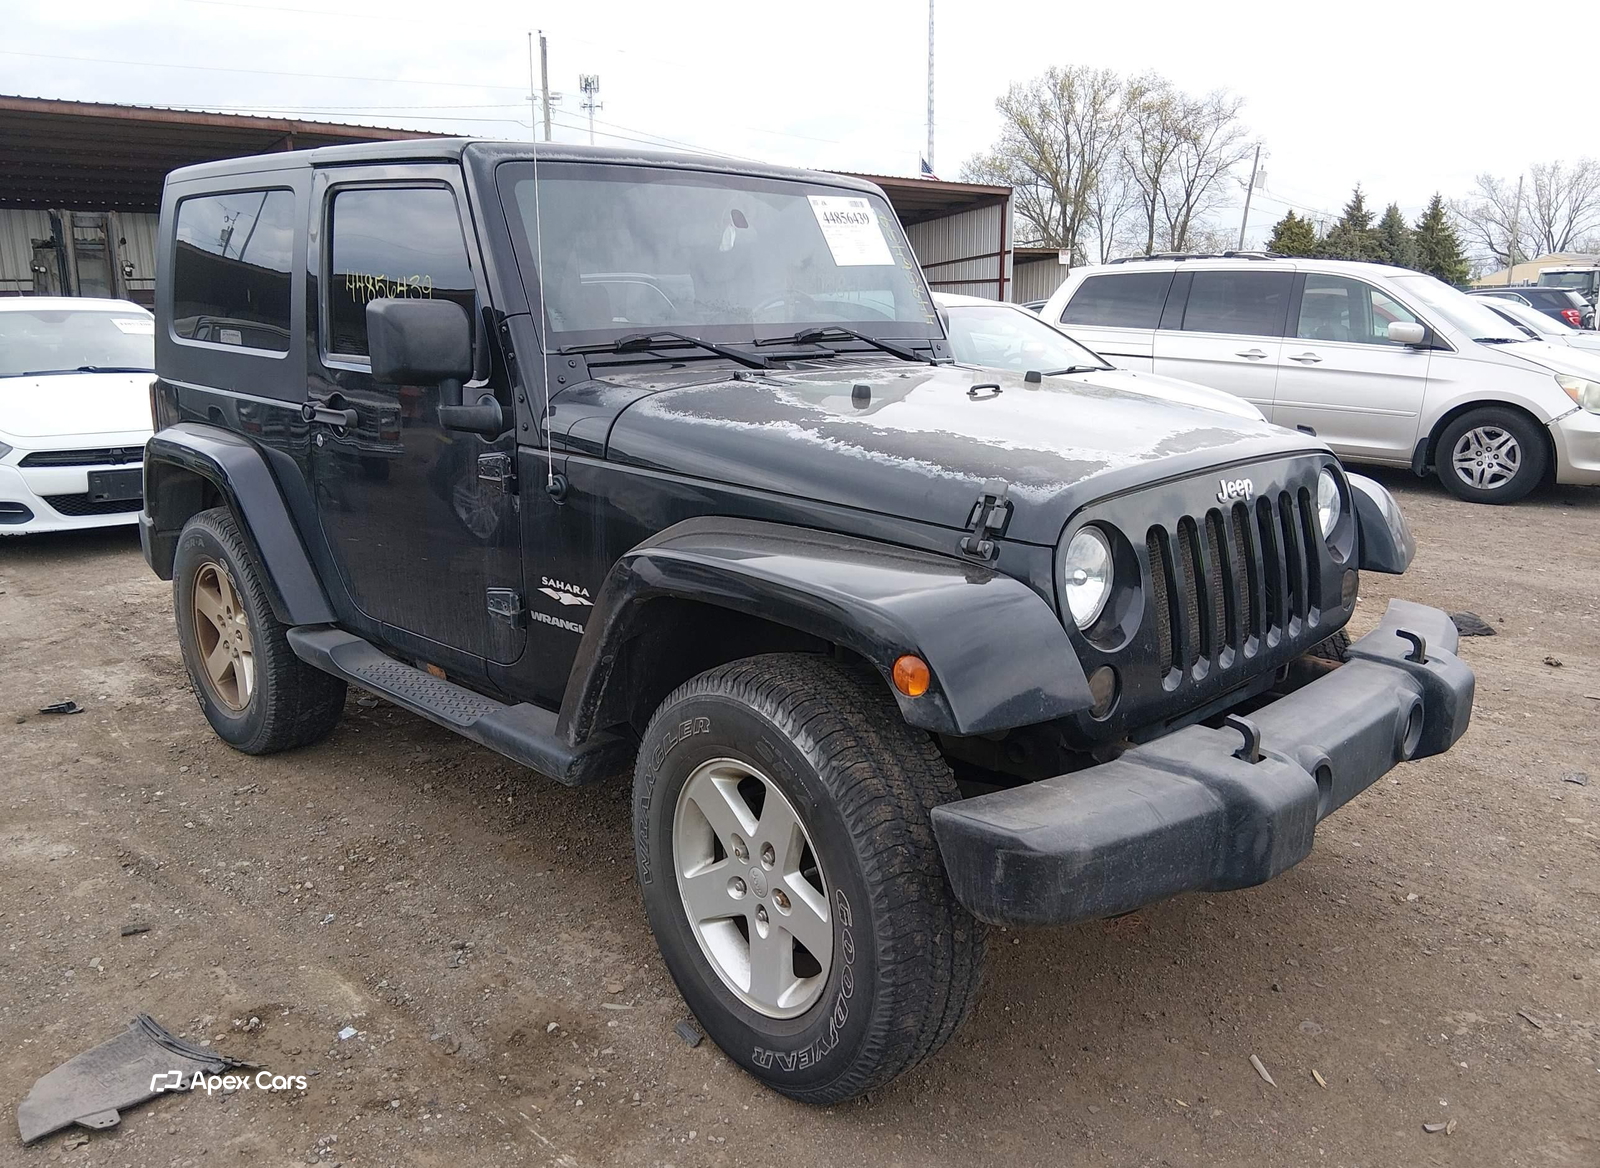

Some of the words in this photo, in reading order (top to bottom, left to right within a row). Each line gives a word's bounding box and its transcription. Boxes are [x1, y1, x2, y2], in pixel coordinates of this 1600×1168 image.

[822, 211, 870, 225] 44856439
[345, 267, 432, 304] 44856439
[1217, 478, 1253, 502] Jeep
[541, 576, 590, 597] SAHARA
[530, 610, 585, 634] WRANGL
[639, 716, 711, 885] WRANGLER
[752, 889, 855, 1072] GOODYEAR
